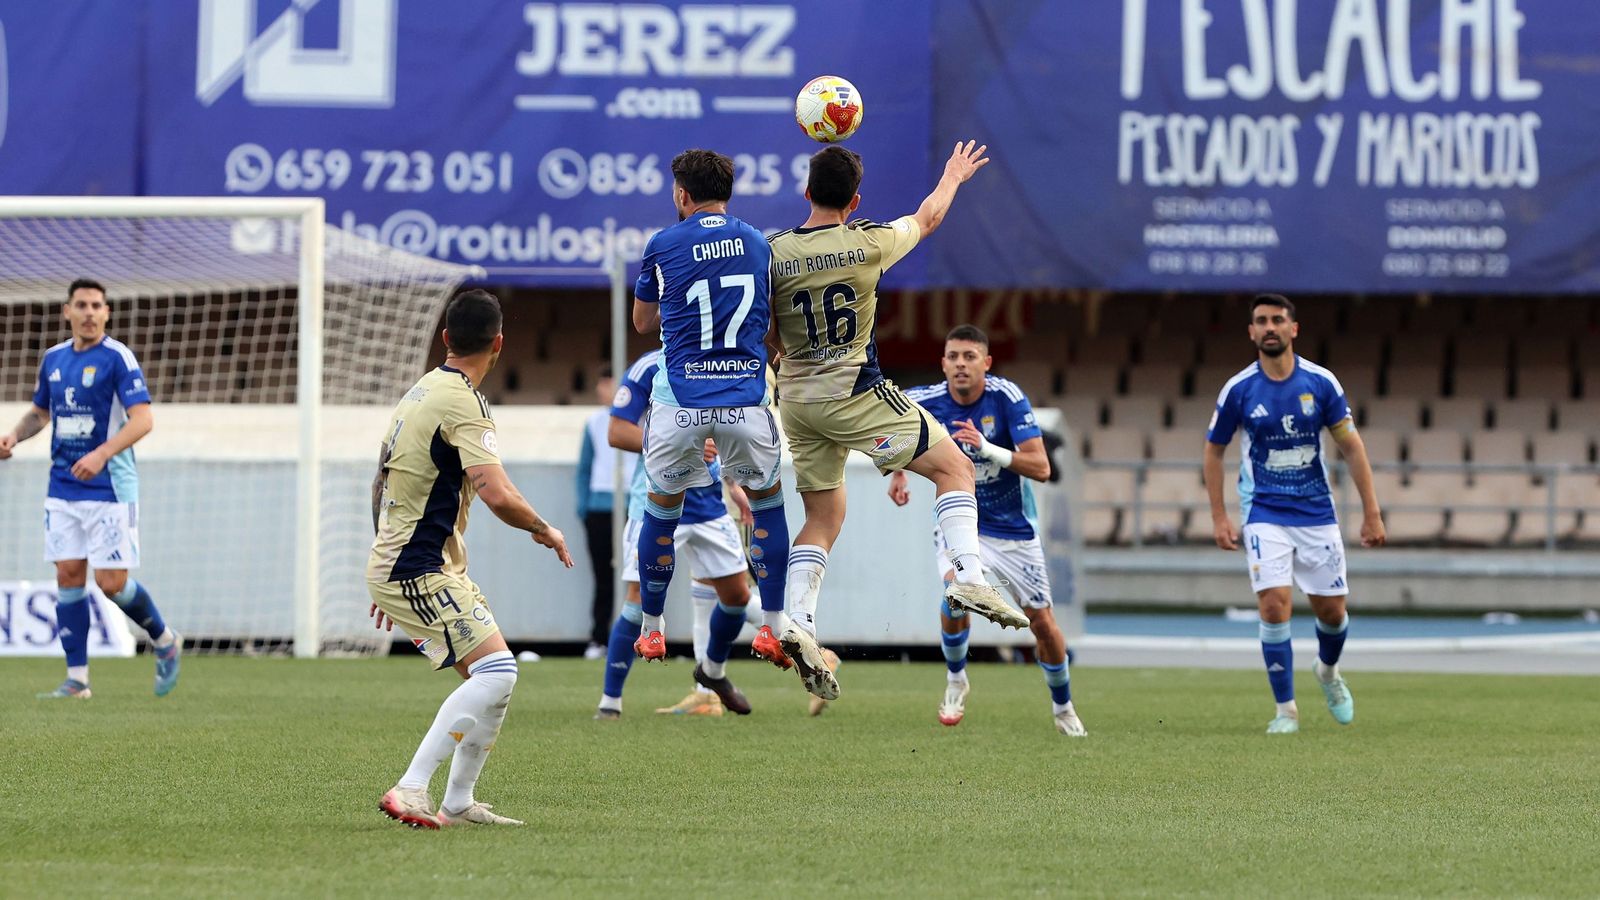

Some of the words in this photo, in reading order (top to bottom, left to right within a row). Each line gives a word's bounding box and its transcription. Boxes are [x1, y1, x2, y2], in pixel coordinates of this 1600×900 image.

[516, 4, 797, 78] JEREZ
[606, 87, 702, 119] .com
[1118, 111, 1300, 187] PESCADOS
[1314, 113, 1344, 187] Y
[1357, 111, 1542, 188] MARISCOS
[275, 148, 351, 191] 659
[362, 150, 434, 193] 723
[444, 151, 513, 194] 051
[588, 153, 664, 195] 856
[1152, 196, 1253, 220] SERVICIO
[1255, 197, 1273, 219] A
[1385, 198, 1486, 221] SERVICIO
[1487, 198, 1505, 220] A
[692, 237, 745, 263] CHUMA
[1386, 225, 1508, 250] DOMICILIO
[773, 258, 801, 278] IVAN
[806, 247, 867, 274] ROMERO
[685, 273, 757, 351] 17
[790, 281, 858, 350] 16
[700, 358, 761, 373] JIMANG
[692, 407, 746, 427] JEALSA
[434, 587, 462, 613] 4
